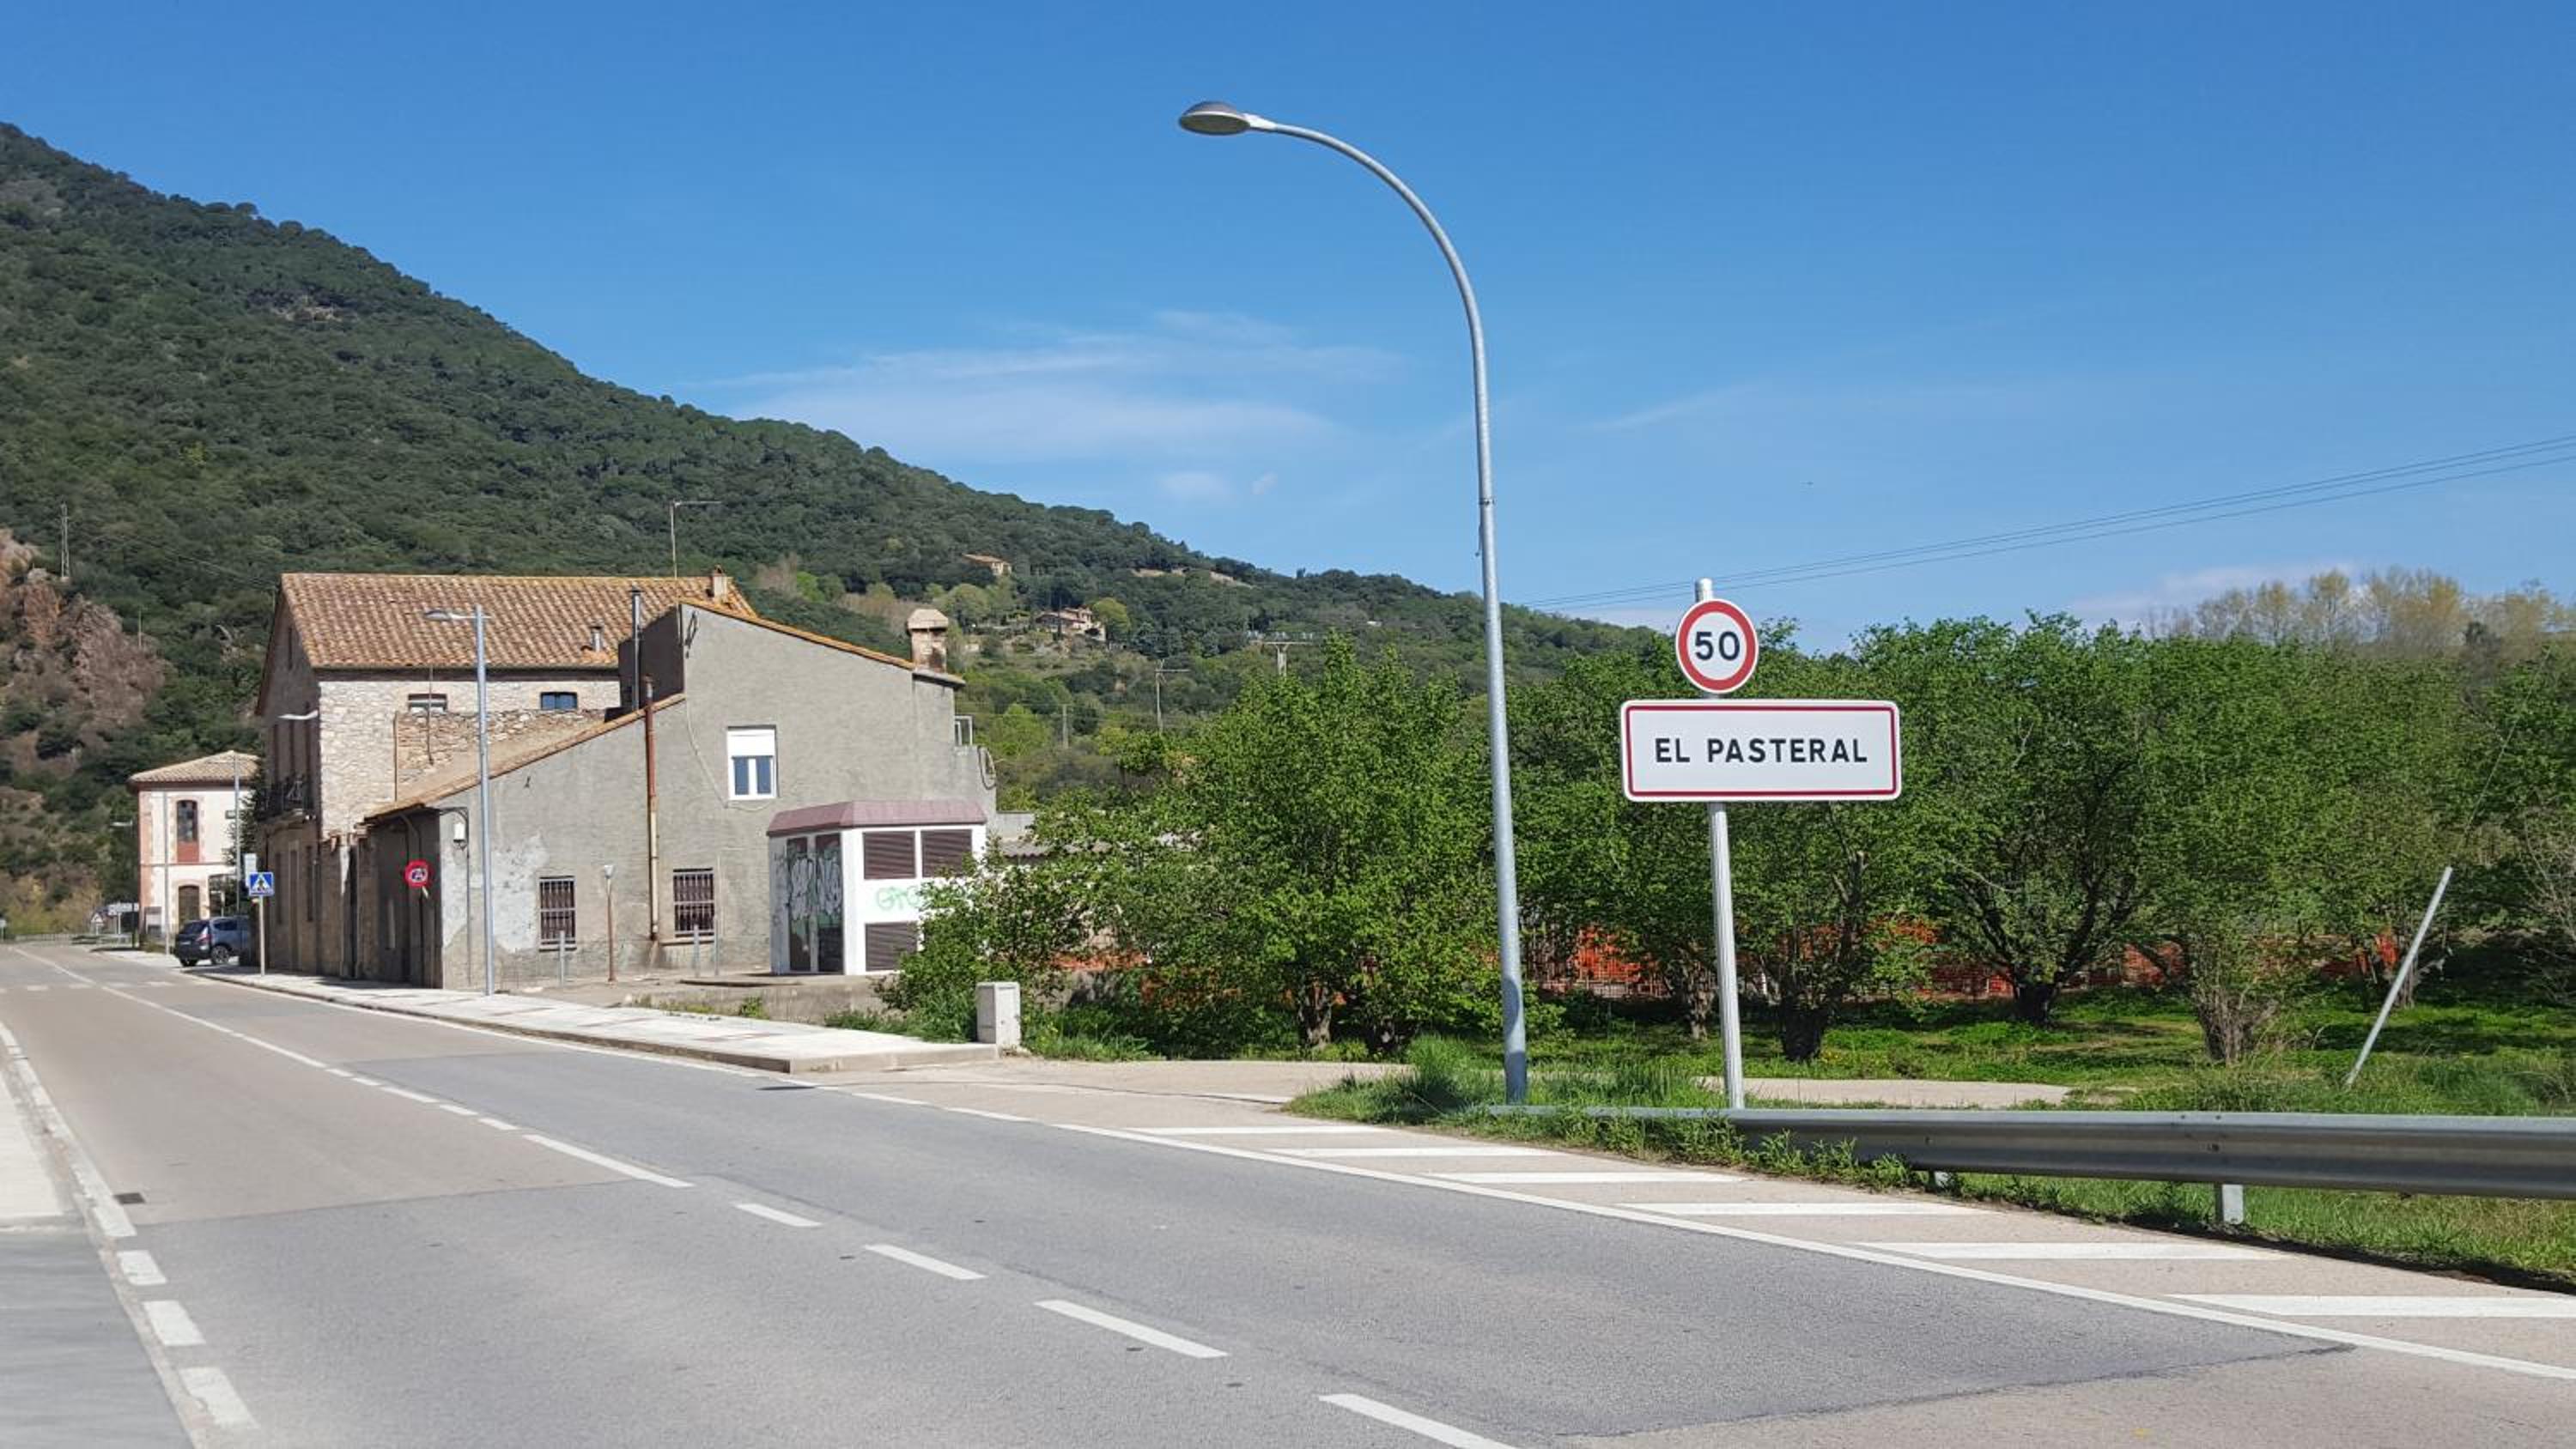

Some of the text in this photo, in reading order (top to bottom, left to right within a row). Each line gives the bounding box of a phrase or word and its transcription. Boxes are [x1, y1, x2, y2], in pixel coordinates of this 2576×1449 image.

[1695, 631, 1741, 661] 50
[1655, 737, 1868, 763] EL PASTERAL
